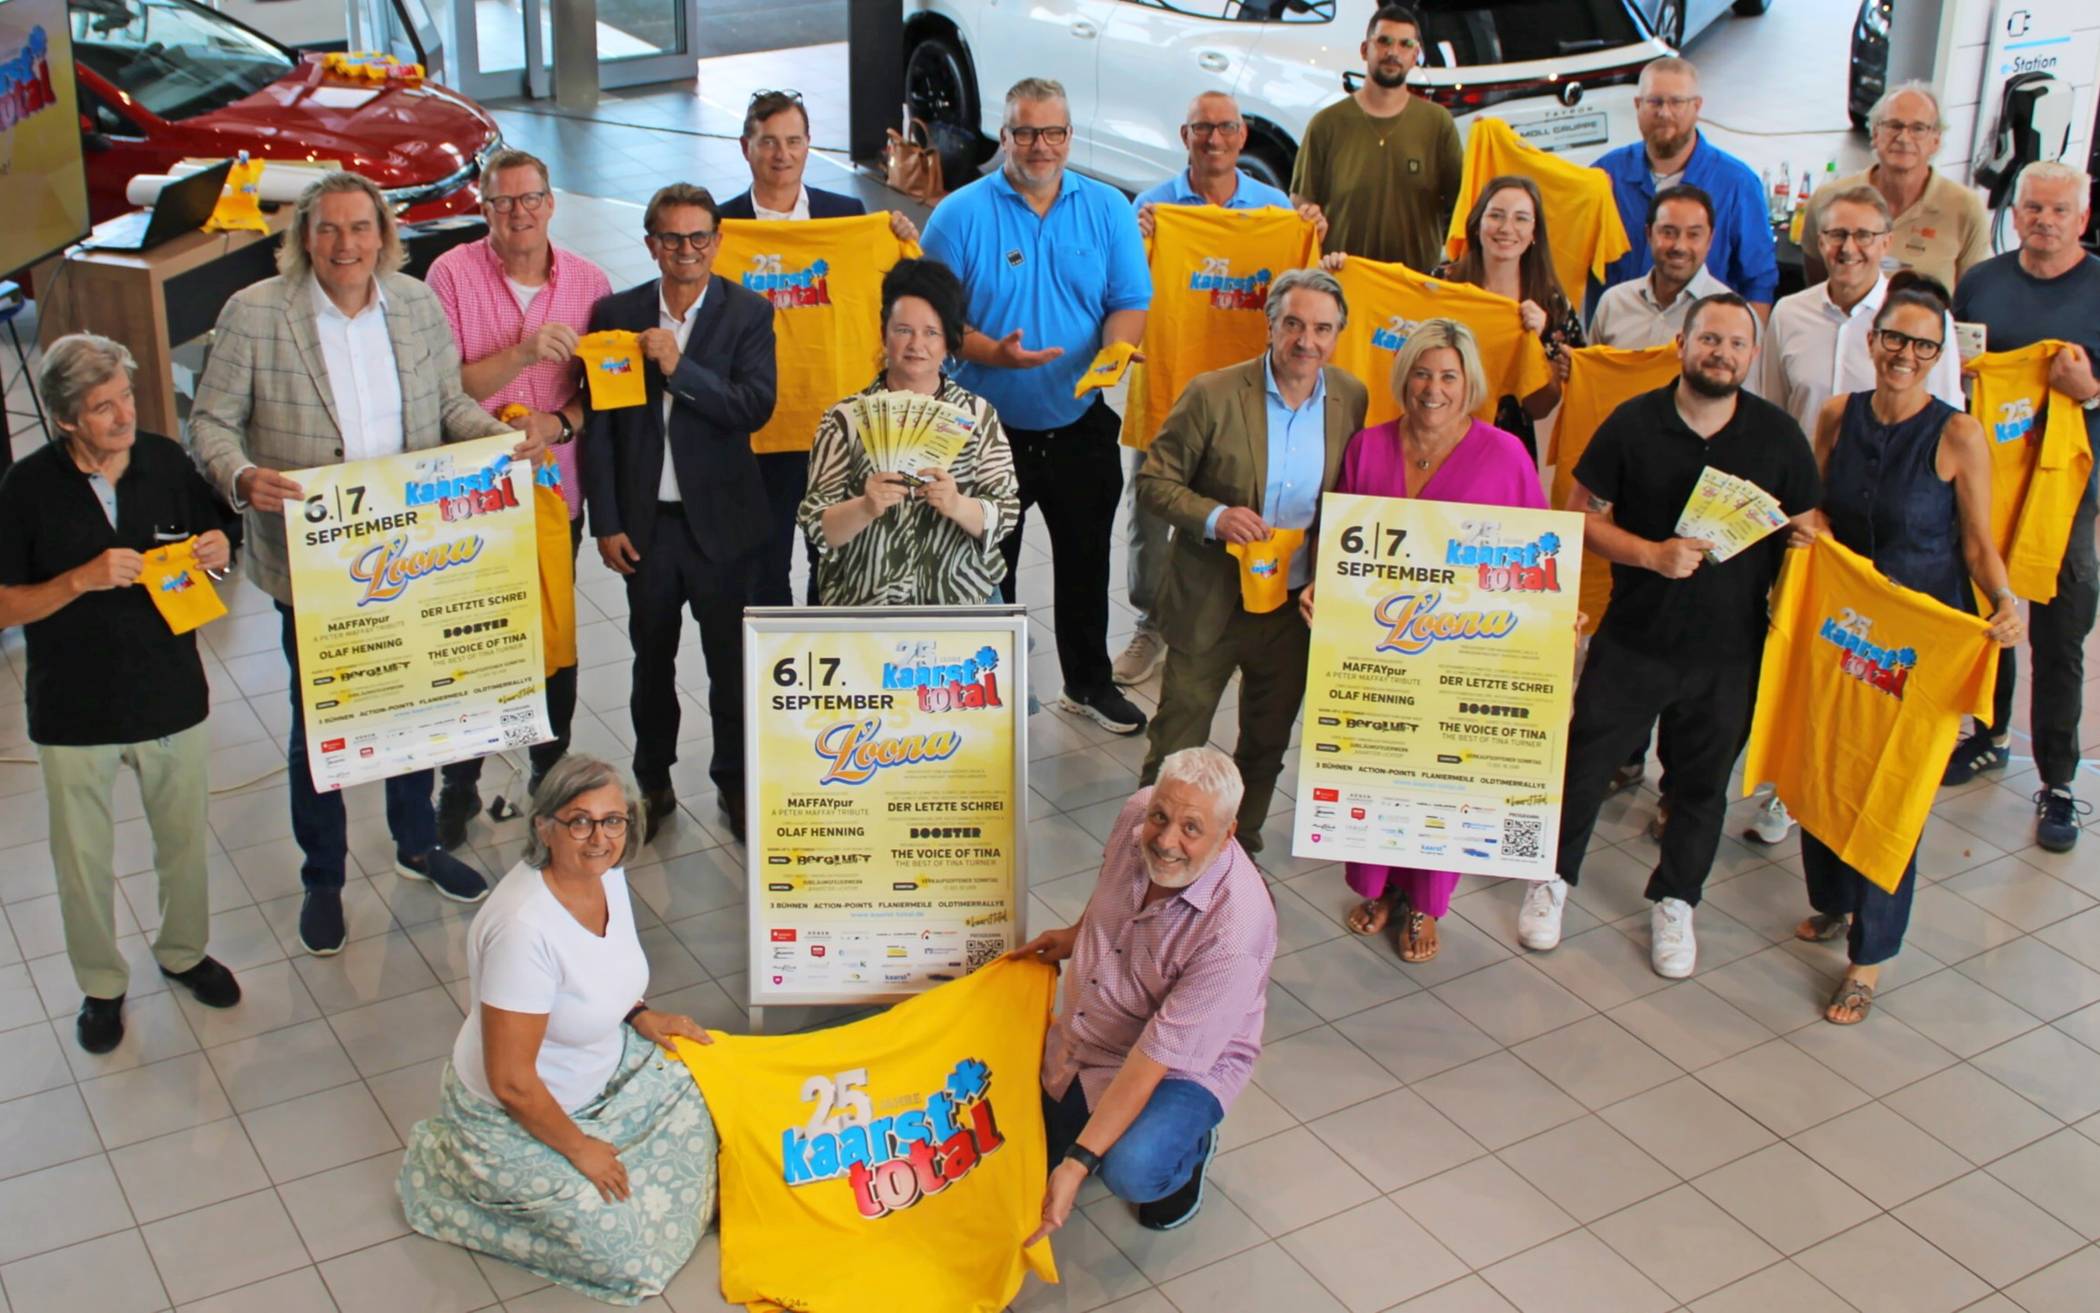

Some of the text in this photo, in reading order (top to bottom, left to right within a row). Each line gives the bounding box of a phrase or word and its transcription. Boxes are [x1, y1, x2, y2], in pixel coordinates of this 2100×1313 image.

[752, 254, 783, 273] 25
[1202, 257, 1231, 277] 25
[742, 268, 813, 292] kaarst
[1190, 271, 1256, 293] kaarst
[767, 277, 832, 309] total
[2000, 397, 2033, 424] 25
[405, 466, 496, 507] kaarst
[439, 476, 519, 522] total
[305, 511, 418, 546] SEPTEMBER
[1446, 538, 1540, 568] kaarst
[1337, 561, 1455, 585] SEPTEMBER
[1478, 557, 1561, 592] total
[421, 606, 442, 618] DER
[446, 599, 485, 613] LETZTE
[488, 591, 527, 606] SCHREI
[328, 616, 390, 632] MAFFAYpur
[1840, 607, 1873, 640] 25
[319, 638, 403, 660] OLAF HENNING
[427, 633, 527, 660] THE VOICE OF TINA
[1820, 616, 1899, 671] kaarst
[882, 658, 978, 691] kaarst
[1342, 662, 1407, 677] MAFFAYpur
[1840, 648, 1908, 702] total
[917, 672, 1002, 713] total
[1440, 675, 1554, 694] DER LETZTE SCHREI
[772, 695, 894, 710] SEPTEMBER
[1329, 689, 1415, 706] OLAF HENNING
[1439, 721, 1547, 740] THE VOICE OF TINA
[1358, 766, 1416, 777] ACTION-POINTS
[1422, 772, 1475, 783] FLANIERMEILE
[1480, 777, 1546, 789] OLDTIMERRALLYE
[787, 798, 854, 810] MAFFAYpur
[888, 801, 1004, 812] DER LETZTE SCHREI
[776, 827, 865, 837] OLAF HENNING
[891, 848, 1001, 859] THE VOICE OF TINA
[938, 900, 1005, 908] OLDTIMERRALLYE
[801, 1068, 873, 1138] 25
[781, 1091, 957, 1187] kaarst
[848, 1098, 1005, 1220] total
